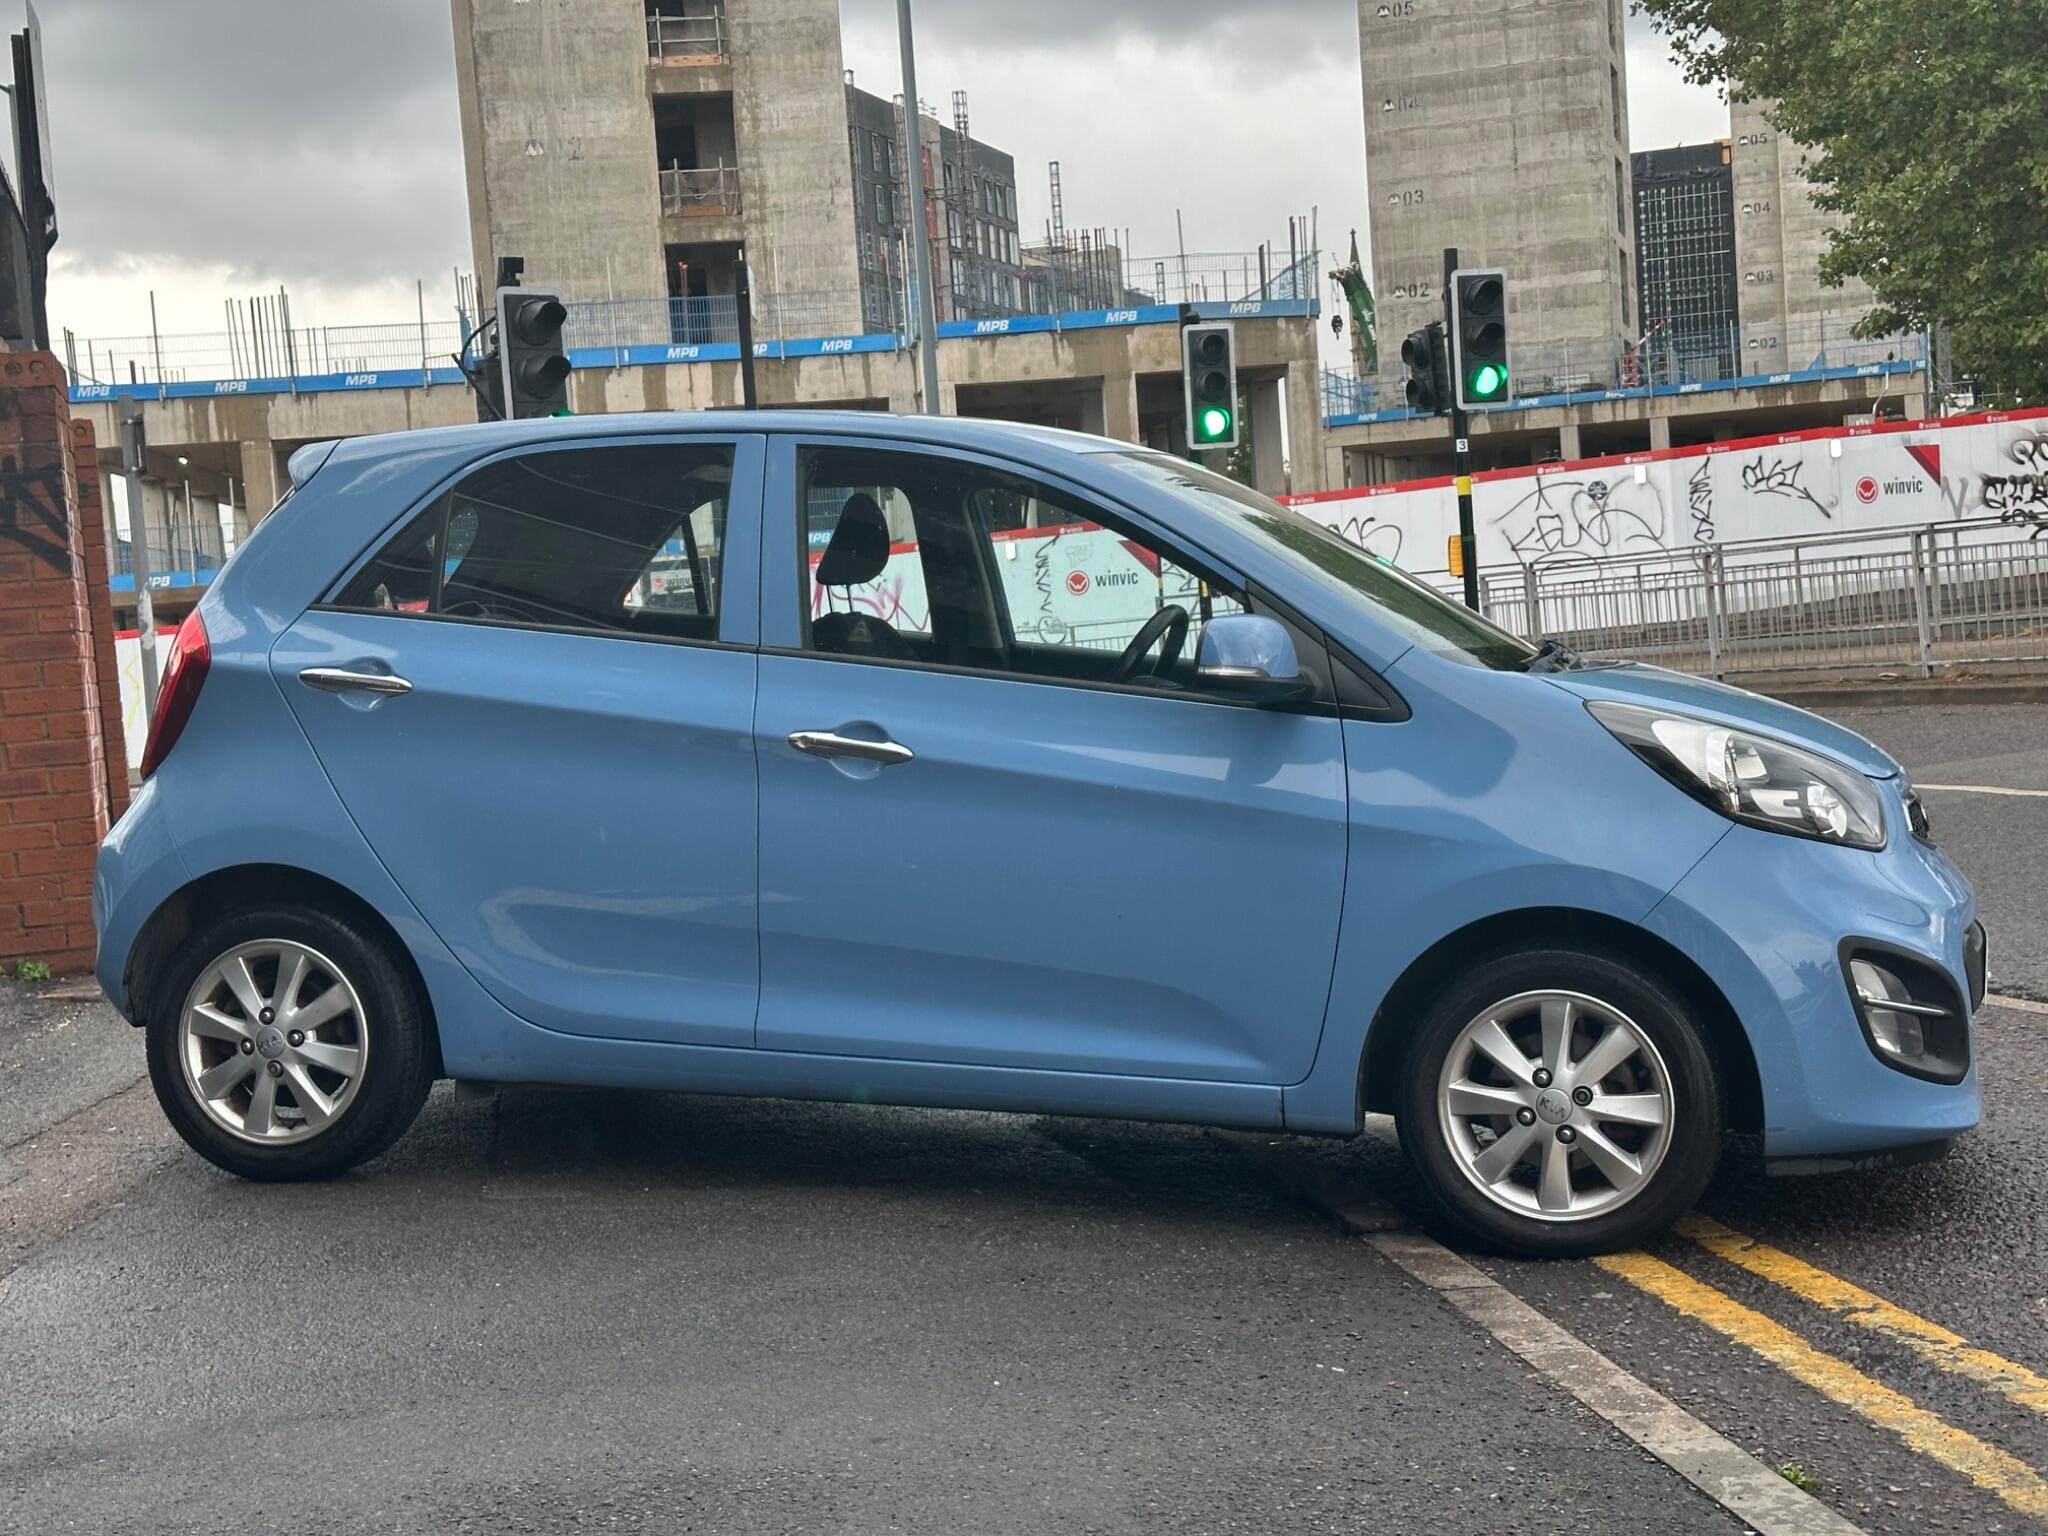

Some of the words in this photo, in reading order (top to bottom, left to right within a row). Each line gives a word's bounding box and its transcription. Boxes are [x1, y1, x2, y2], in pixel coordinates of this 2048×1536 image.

[1393, 1, 1414, 18] 05
[1751, 133, 1767, 145] 05
[1403, 189, 1424, 206] 03
[1754, 201, 1770, 214] 04
[1757, 270, 1774, 282] 03
[1408, 283, 1429, 298] 02
[1229, 302, 1261, 314] MPB
[1105, 310, 1136, 323] MPB
[976, 320, 1008, 333] MPB
[821, 339, 852, 352] MPB
[1760, 337, 1777, 348] 02
[667, 346, 698, 359] MPB
[345, 374, 377, 386] MPB
[77, 386, 110, 398] MPB
[214, 381, 247, 393] MPB
[1458, 441, 1467, 451] 3
[1883, 476, 1922, 494] winvic
[148, 575, 171, 588] PB
[1095, 568, 1138, 586] winvic
